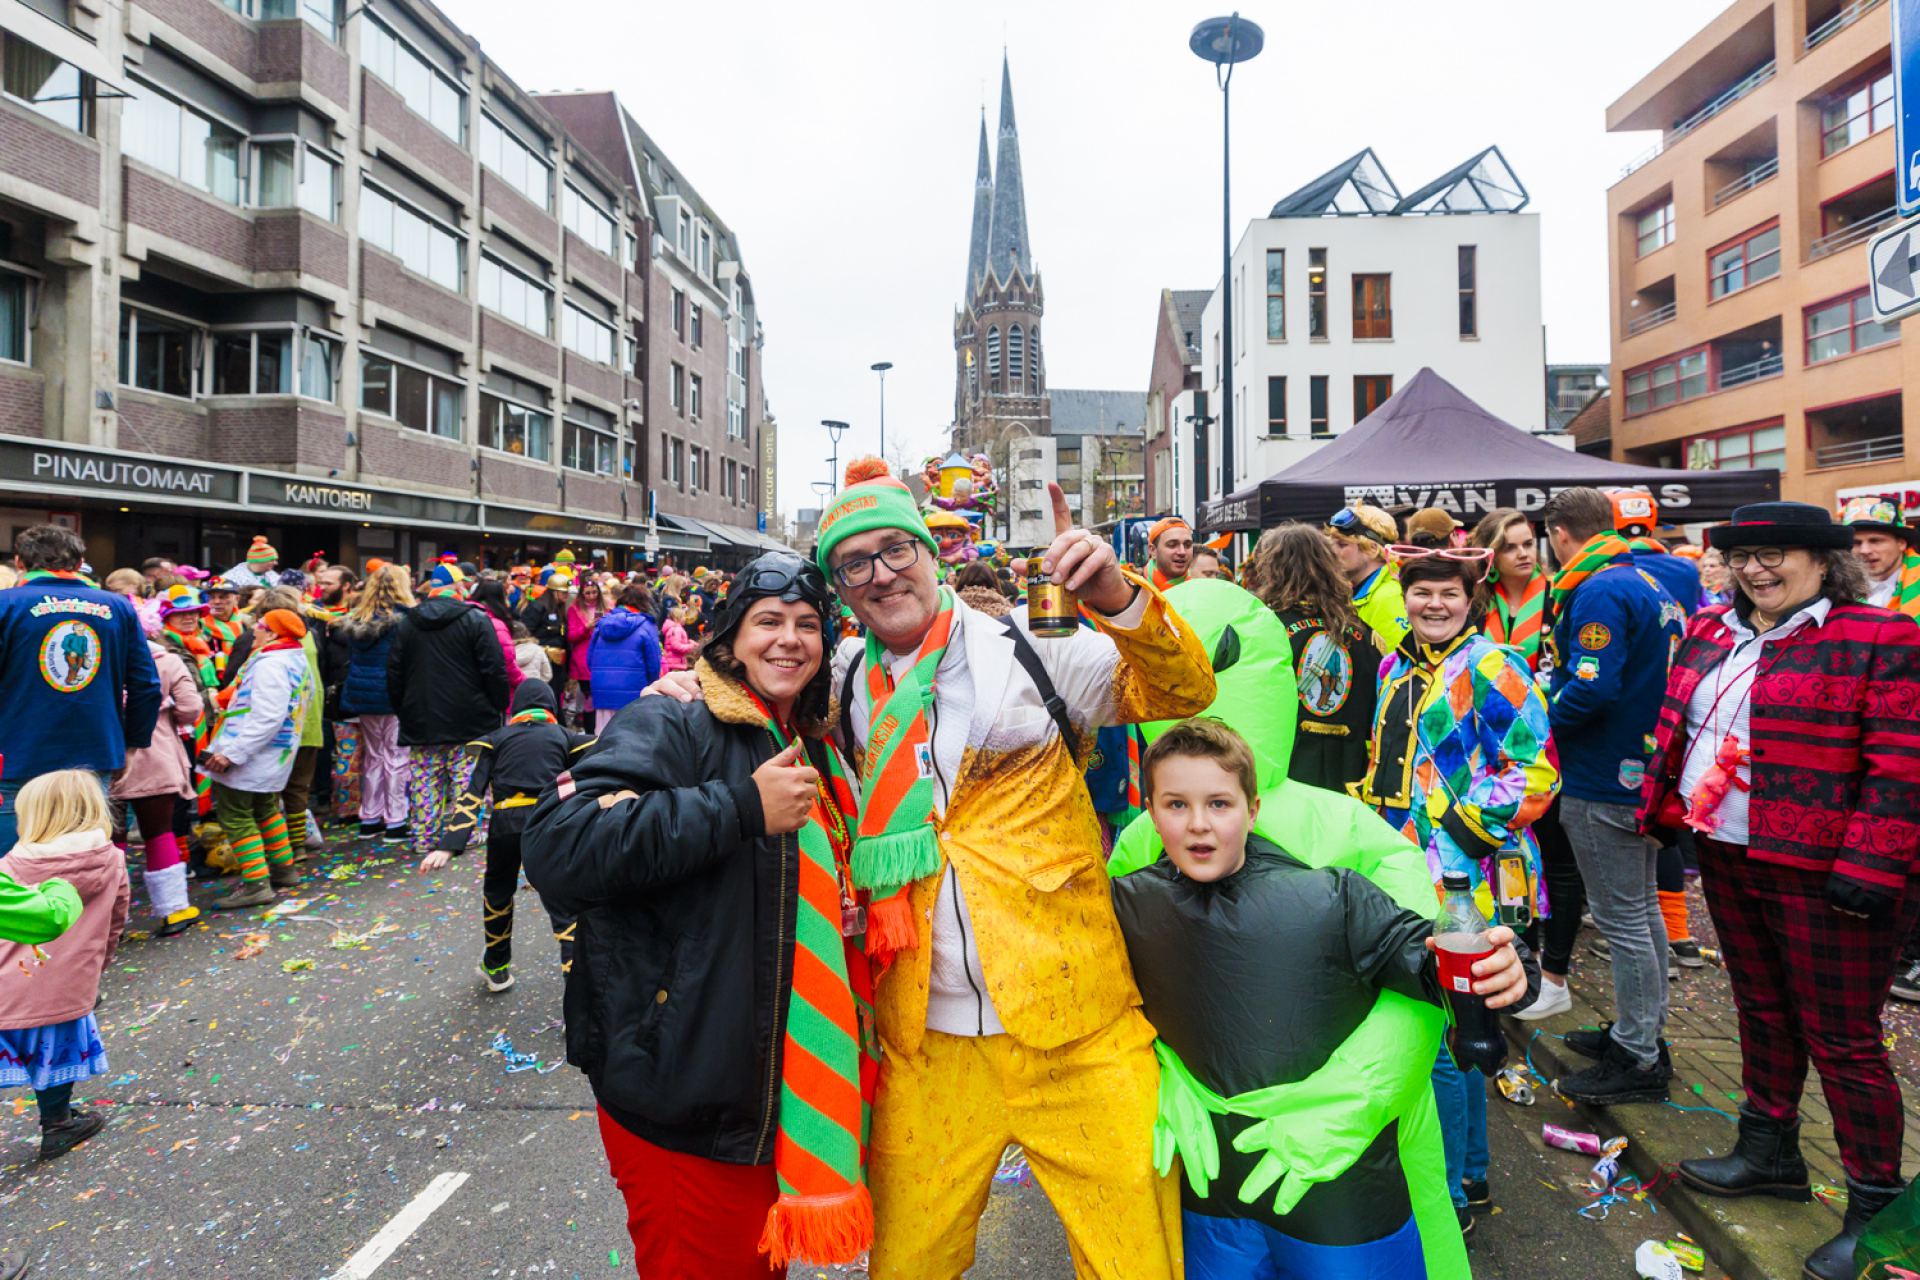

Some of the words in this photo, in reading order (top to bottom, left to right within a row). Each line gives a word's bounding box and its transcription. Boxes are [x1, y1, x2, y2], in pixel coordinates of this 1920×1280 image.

[766, 431, 774, 462] HOTEL
[33, 453, 214, 494] PINAUTOMAAT
[285, 484, 372, 510] KANTOREN
[765, 467, 774, 519] Mercure
[1397, 488, 1497, 513] VAN
